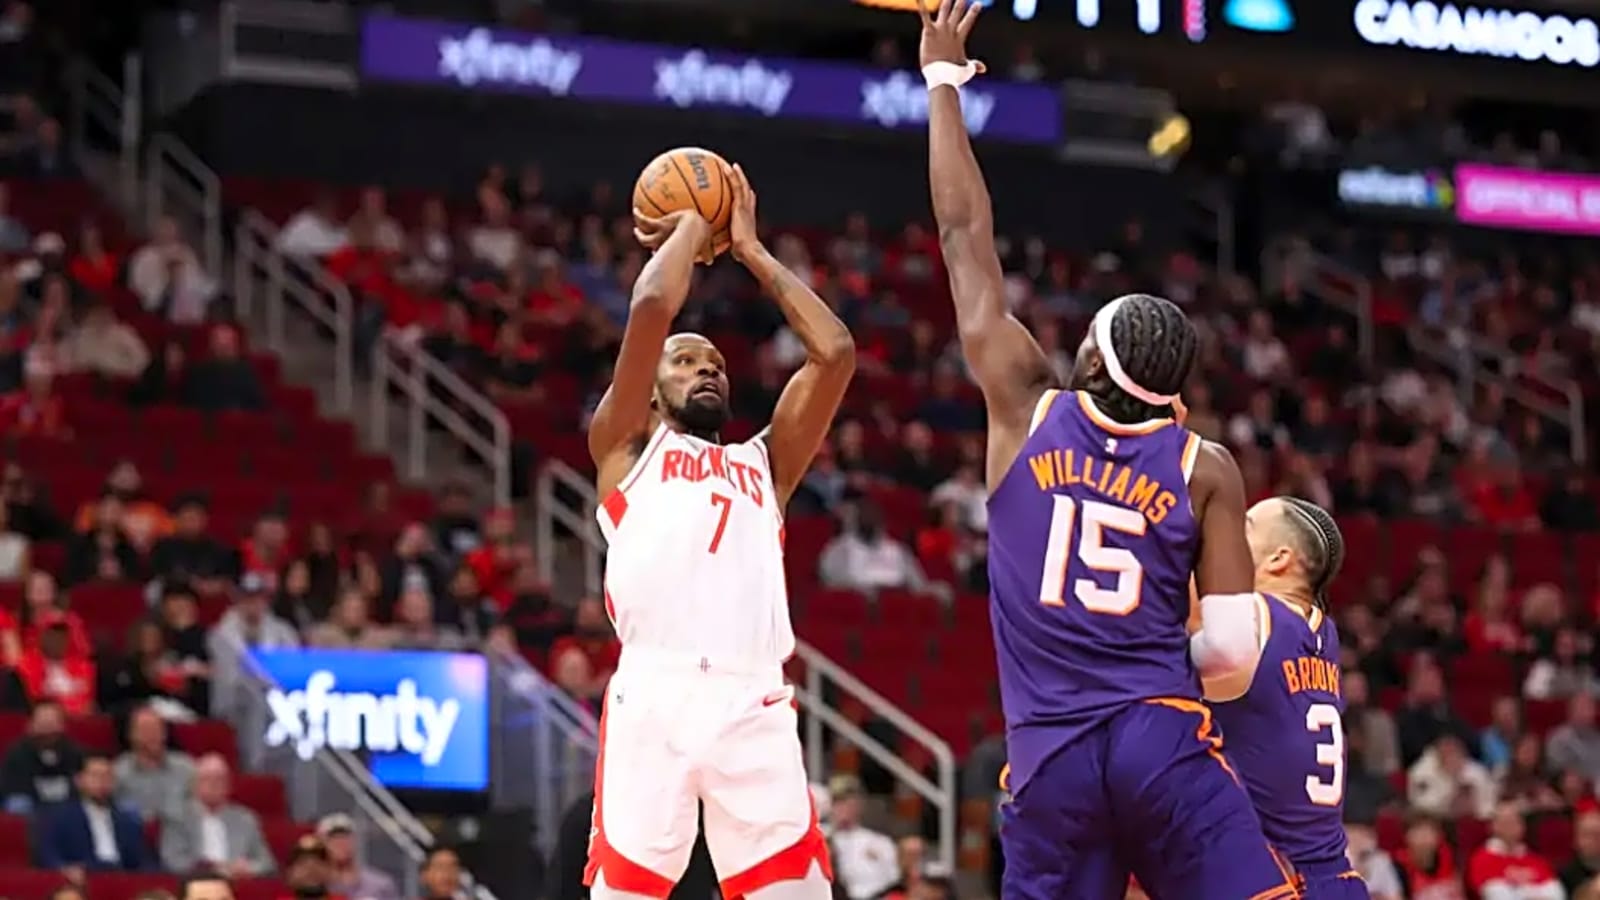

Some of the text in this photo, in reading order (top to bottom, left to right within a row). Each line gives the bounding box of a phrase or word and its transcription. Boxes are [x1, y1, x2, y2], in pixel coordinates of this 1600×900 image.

[1354, 0, 1600, 67] CASAMIGOS
[661, 446, 763, 508] ROCKTS
[1029, 449, 1177, 524] WILLIAMS
[708, 492, 732, 554] 7
[1040, 494, 1147, 616] 15
[1282, 656, 1340, 700] BROOK
[265, 670, 460, 767] xfinity
[1305, 704, 1343, 806] 3
